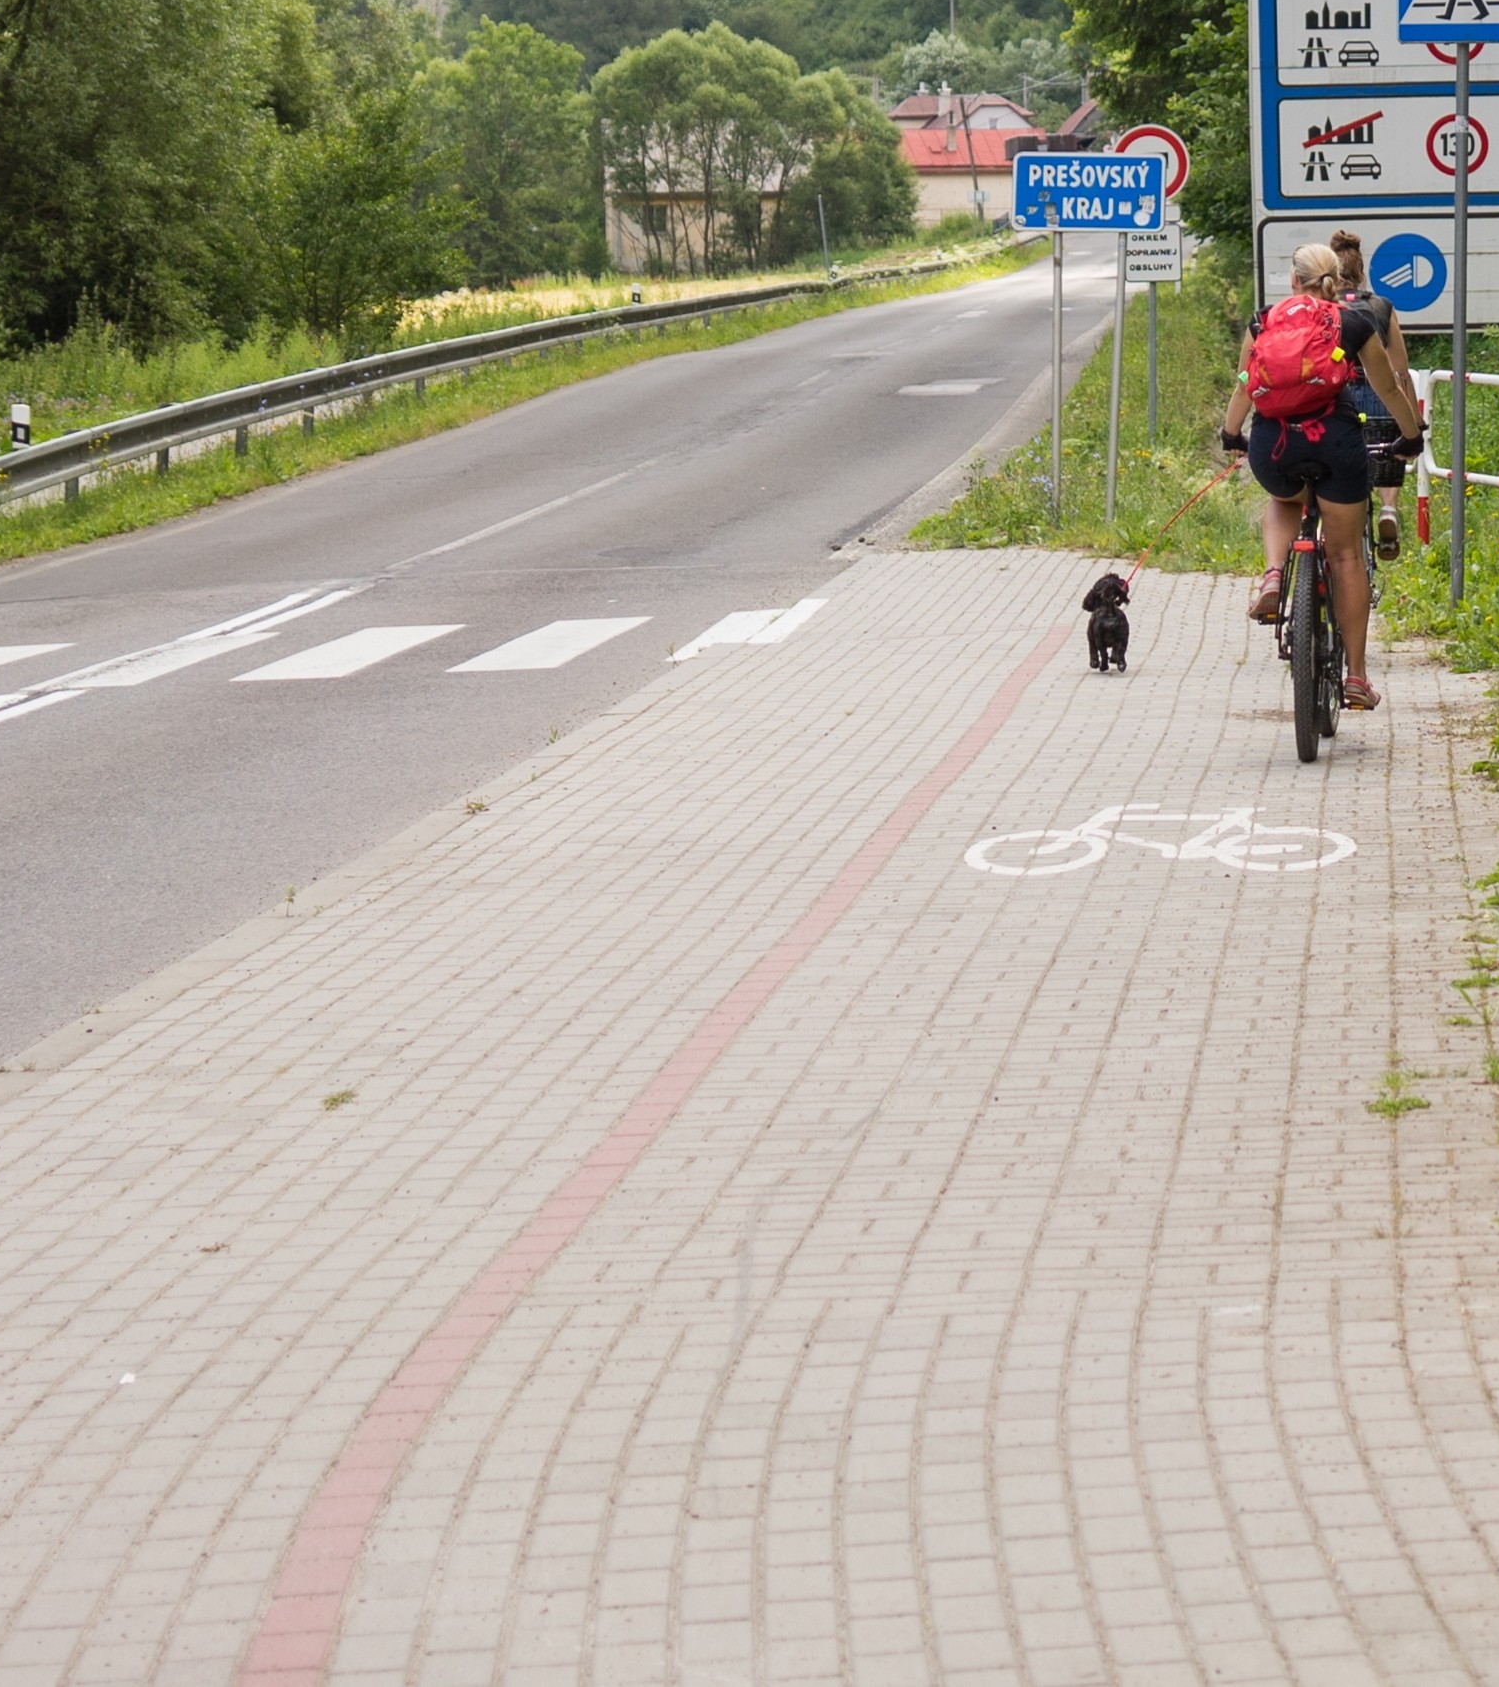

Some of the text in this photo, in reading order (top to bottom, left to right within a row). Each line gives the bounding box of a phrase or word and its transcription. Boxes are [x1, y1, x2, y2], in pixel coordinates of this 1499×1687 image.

[1029, 160, 1149, 188] PREŠOVSKÝ
[1062, 197, 1114, 220] KRAJ
[1131, 234, 1168, 242] OKREM
